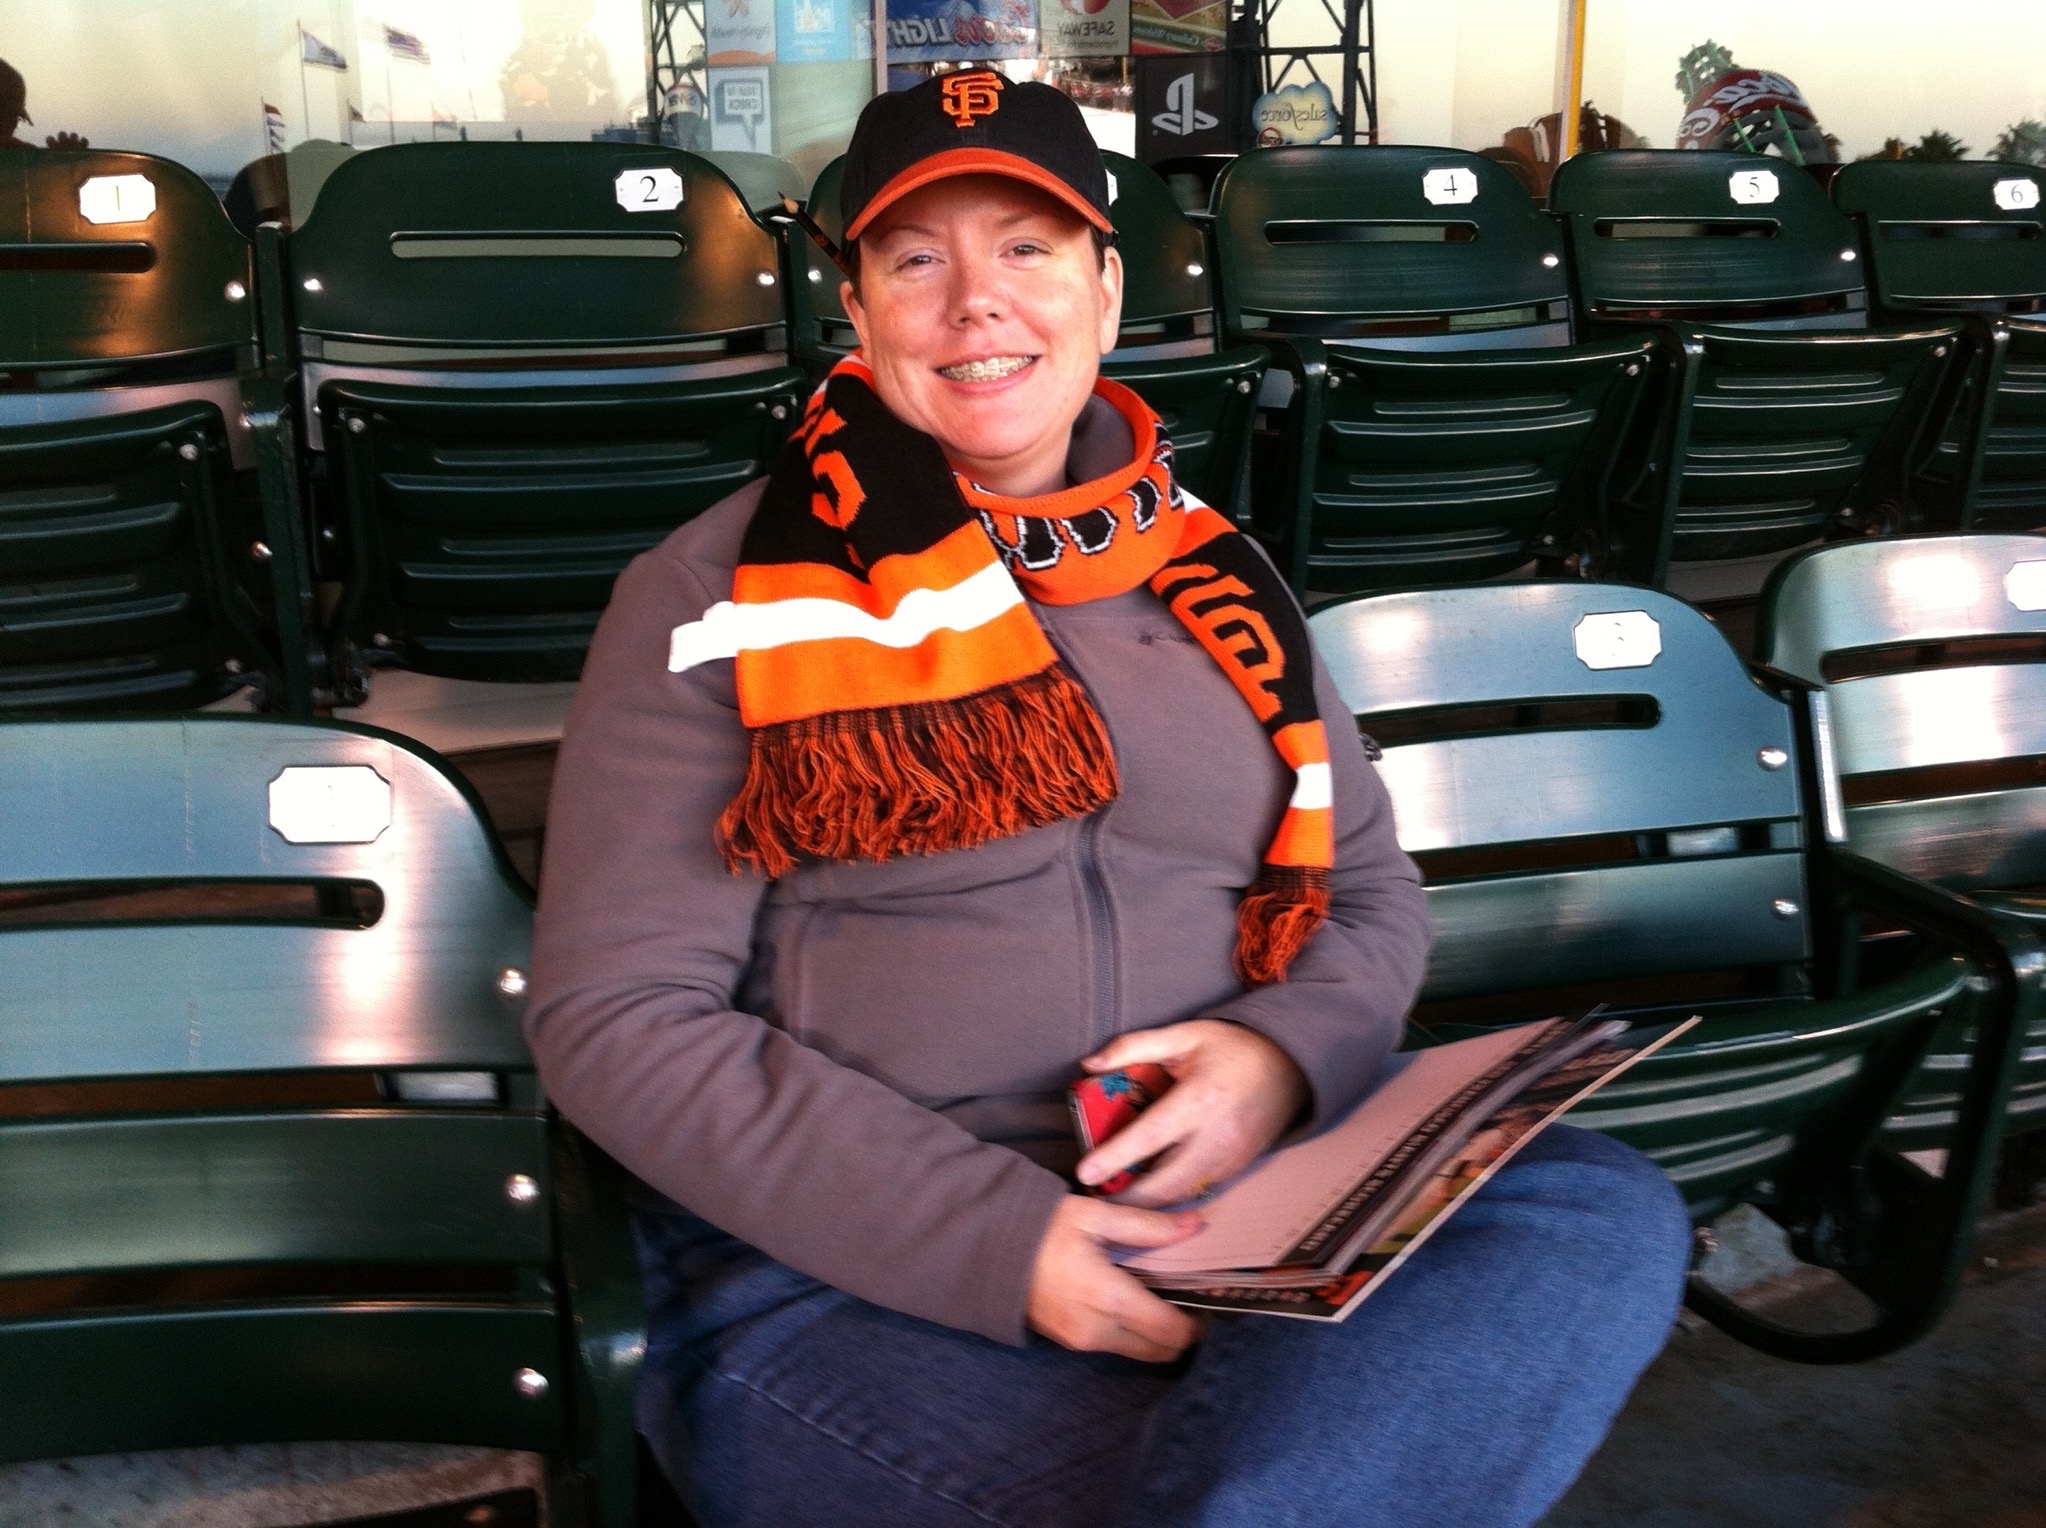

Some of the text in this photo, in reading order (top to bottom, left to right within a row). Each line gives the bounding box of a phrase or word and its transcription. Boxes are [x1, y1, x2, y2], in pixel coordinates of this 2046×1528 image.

[942, 72, 1004, 128] SF
[640, 175, 660, 203] 2
[1443, 174, 1458, 196] 4
[1749, 176, 1760, 198] 5
[2010, 183, 2024, 204] 6
